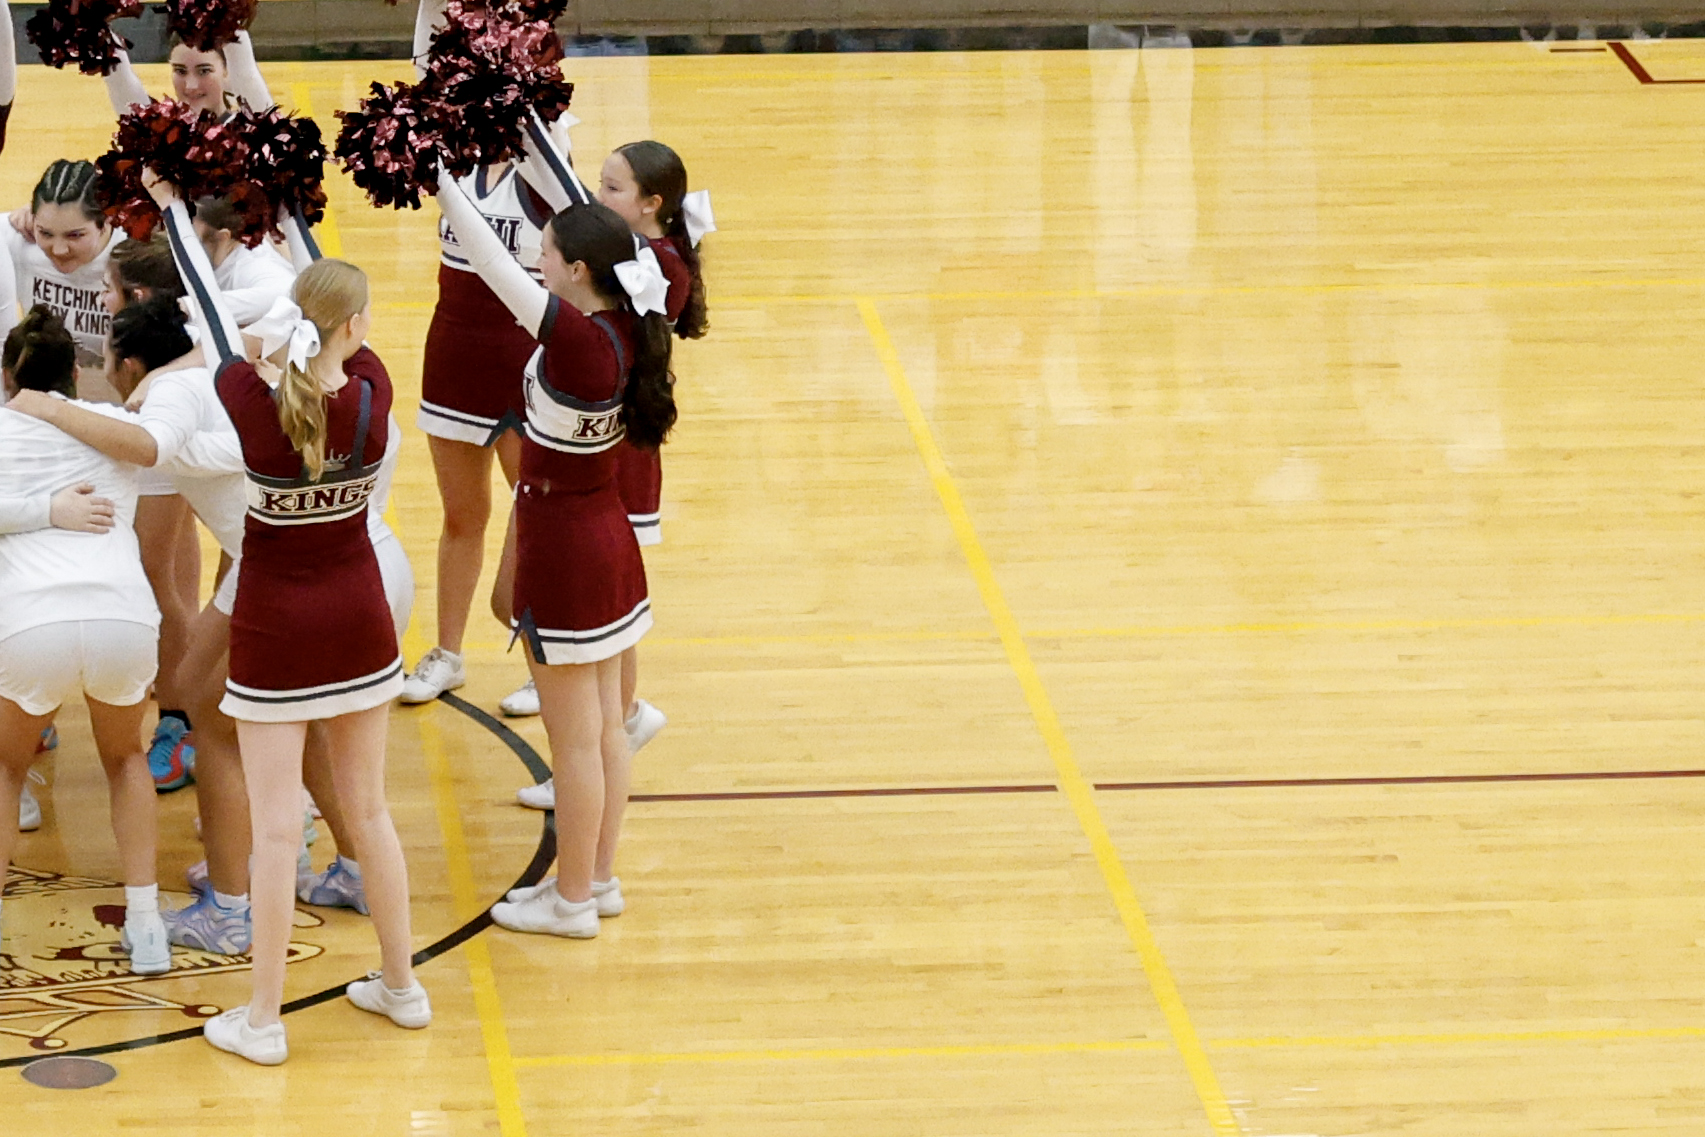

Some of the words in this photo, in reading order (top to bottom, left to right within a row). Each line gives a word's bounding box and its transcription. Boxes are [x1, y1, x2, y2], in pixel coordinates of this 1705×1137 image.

[32, 276, 109, 312] KETCHIK
[74, 310, 113, 336] KING
[260, 476, 378, 514] KINGS
